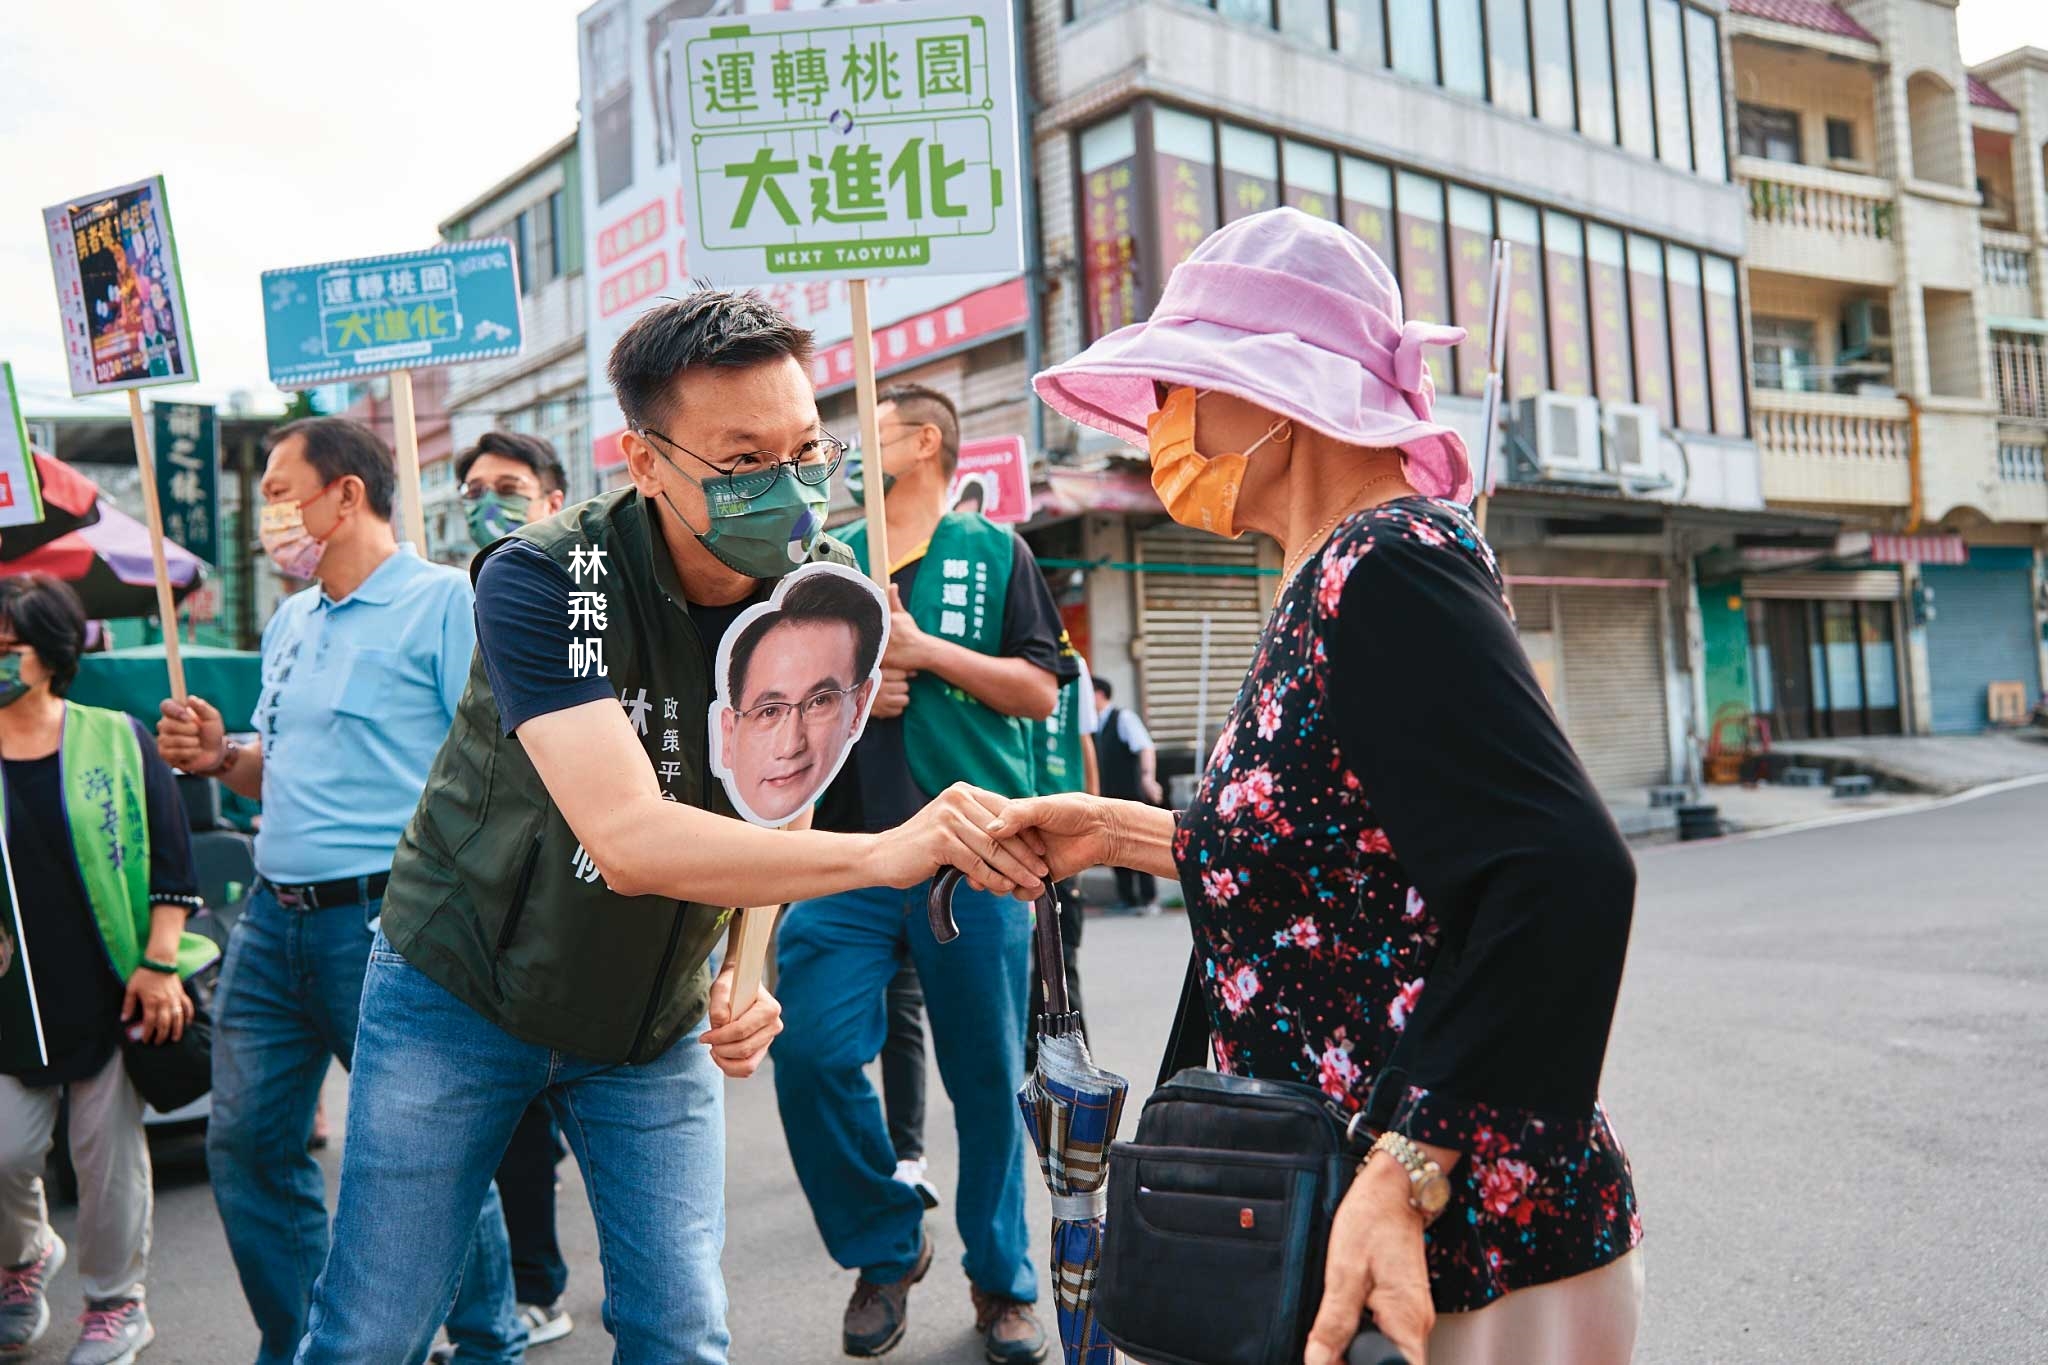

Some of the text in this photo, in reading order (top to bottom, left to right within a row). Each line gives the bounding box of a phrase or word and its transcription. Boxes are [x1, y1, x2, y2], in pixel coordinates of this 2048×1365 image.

[702, 34, 973, 114] 運轉桃園
[724, 137, 968, 230] 大進化
[774, 244, 921, 266] NEXT TAOYUAN
[324, 265, 448, 304] 運轉桃園
[335, 303, 448, 348] 大進化
